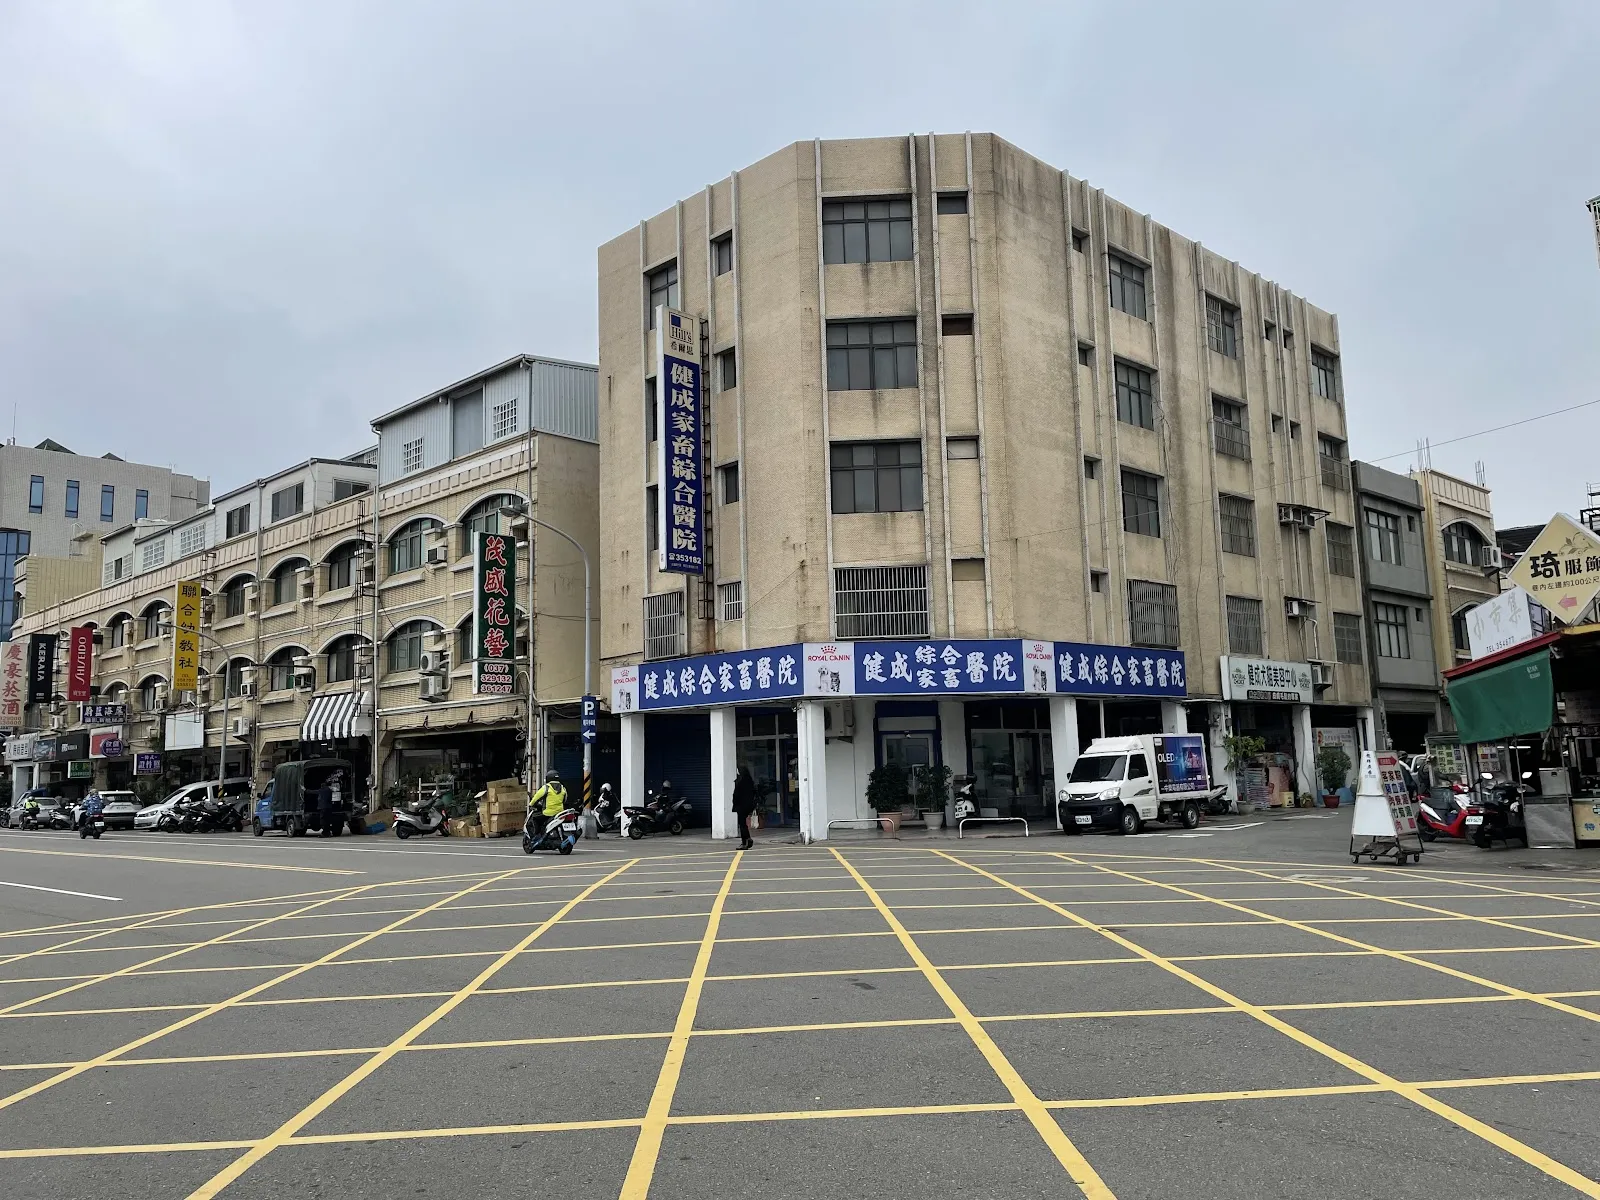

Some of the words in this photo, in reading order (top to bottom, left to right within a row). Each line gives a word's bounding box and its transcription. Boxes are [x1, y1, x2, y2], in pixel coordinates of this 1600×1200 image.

[670, 362, 697, 552] 健成家畜綜合醫院
[675, 553, 702, 567] 353182
[484, 536, 509, 657] 茂盛花藝
[75, 636, 87, 685] SHISEIDO
[484, 663, 509, 673] (037)
[863, 652, 914, 683] 健成
[914, 644, 963, 666] 綜合
[966, 652, 1017, 684] 醫院
[1058, 651, 1185, 688] 健成綜合家畜醫院
[480, 674, 513, 684] 329132
[643, 654, 798, 700] 健成綜合家畜醫院
[916, 667, 962, 689] 家畜
[584, 701, 594, 716] P
